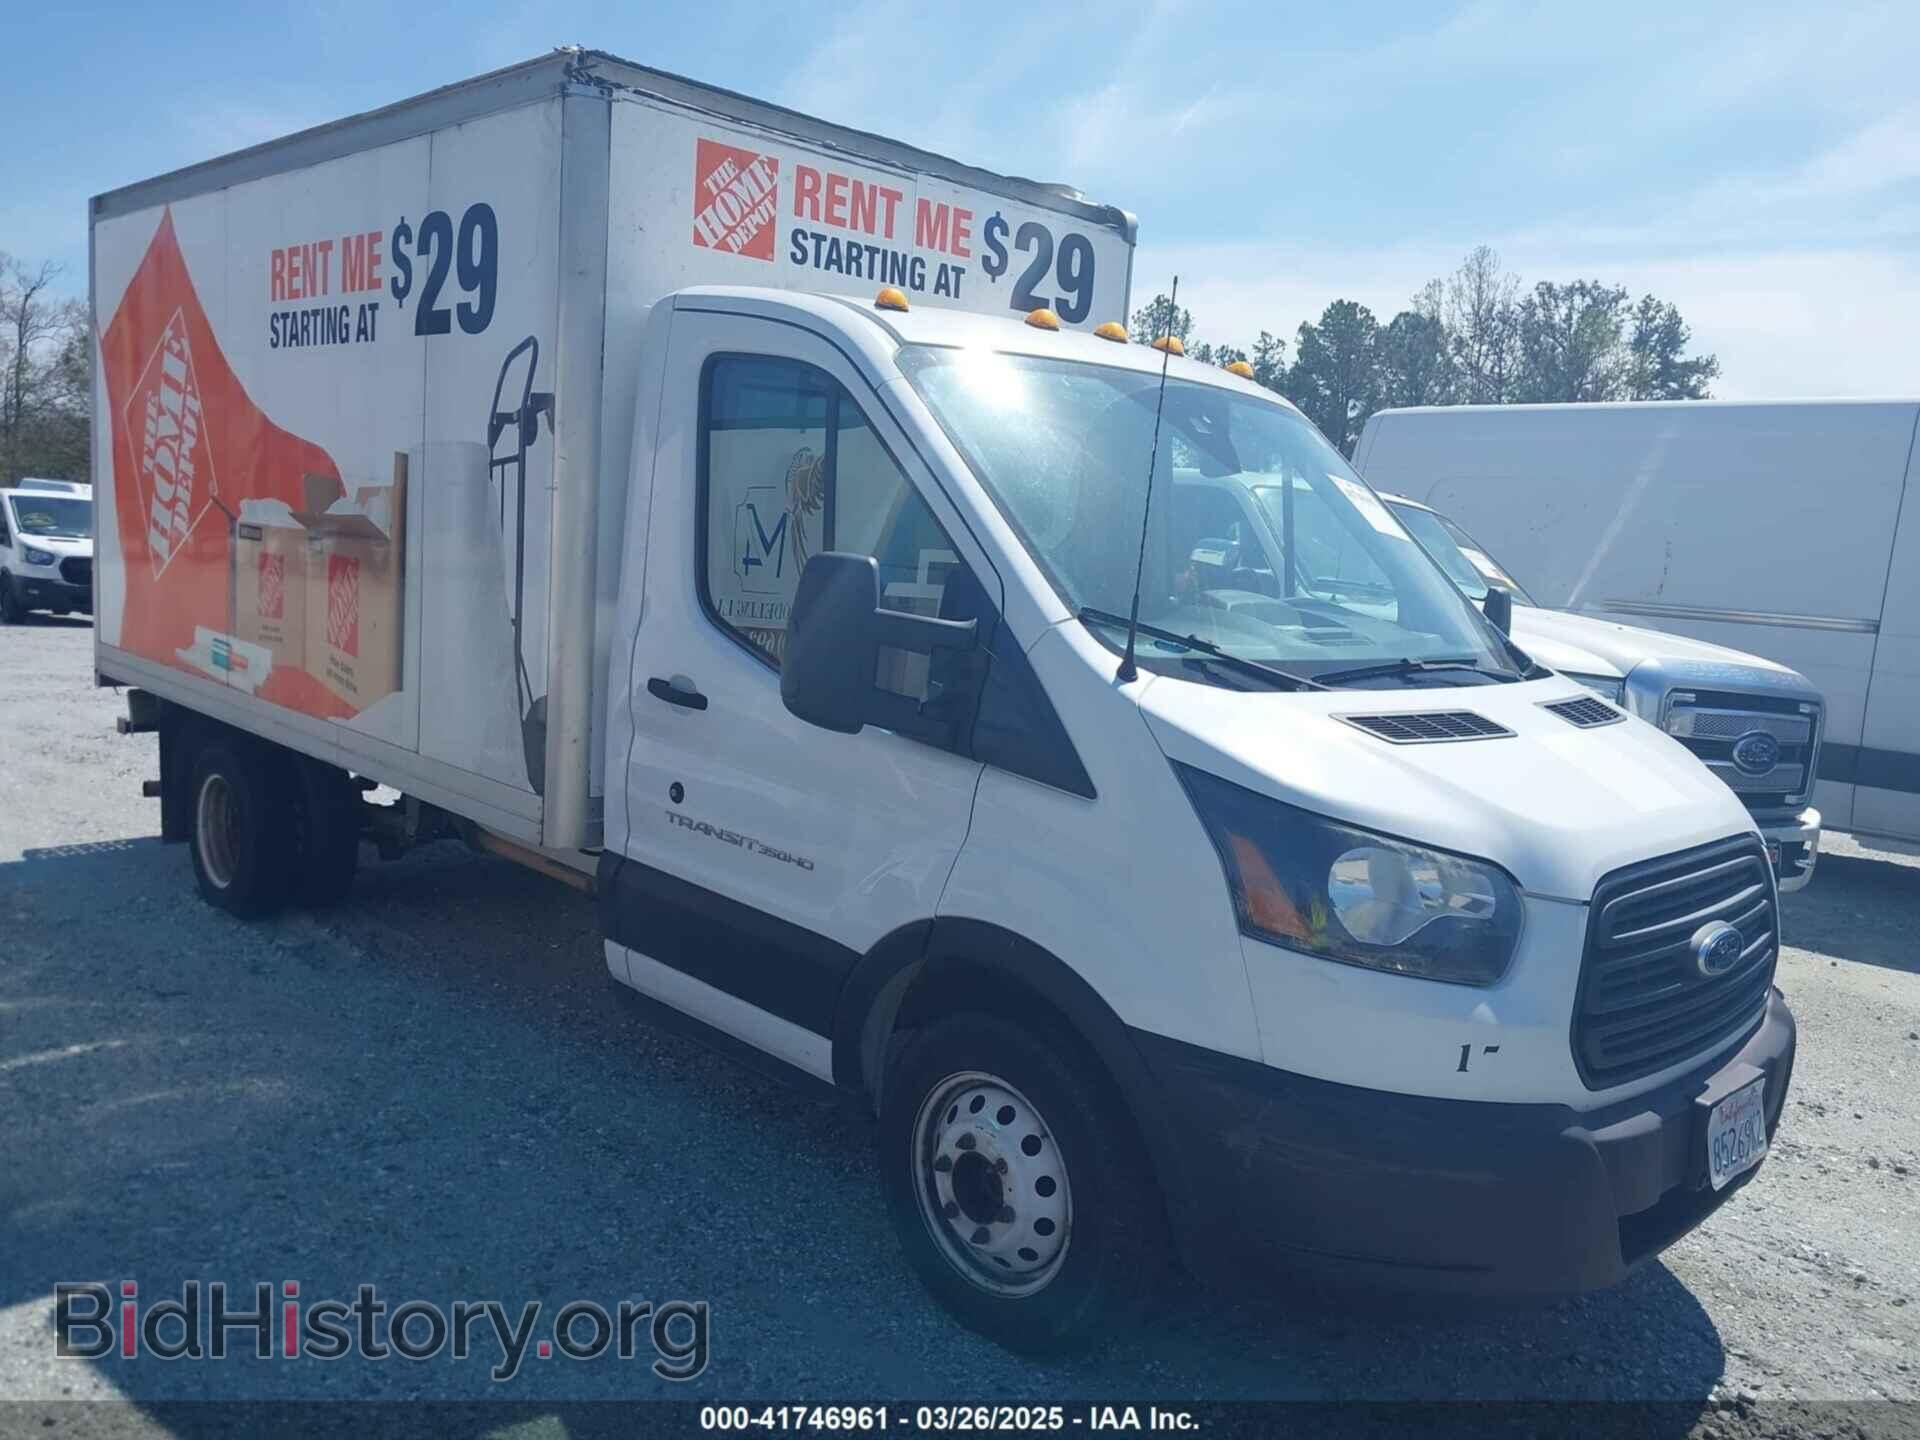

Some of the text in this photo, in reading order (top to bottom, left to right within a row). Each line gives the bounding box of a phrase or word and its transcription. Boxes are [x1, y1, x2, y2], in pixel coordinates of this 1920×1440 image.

[691, 155, 777, 249] HOME
[704, 157, 739, 197] THE
[793, 164, 974, 258] RENT ME
[725, 195, 777, 253] DEPOT
[790, 227, 966, 300] STARTING AT
[271, 230, 383, 302] RENT ME
[390, 202, 499, 337] $29
[981, 210, 1096, 325] $29
[269, 302, 380, 349] STARTING AT
[150, 328, 191, 562] HOME
[170, 385, 201, 538] DEPOT
[665, 810, 759, 851] TRANSIT
